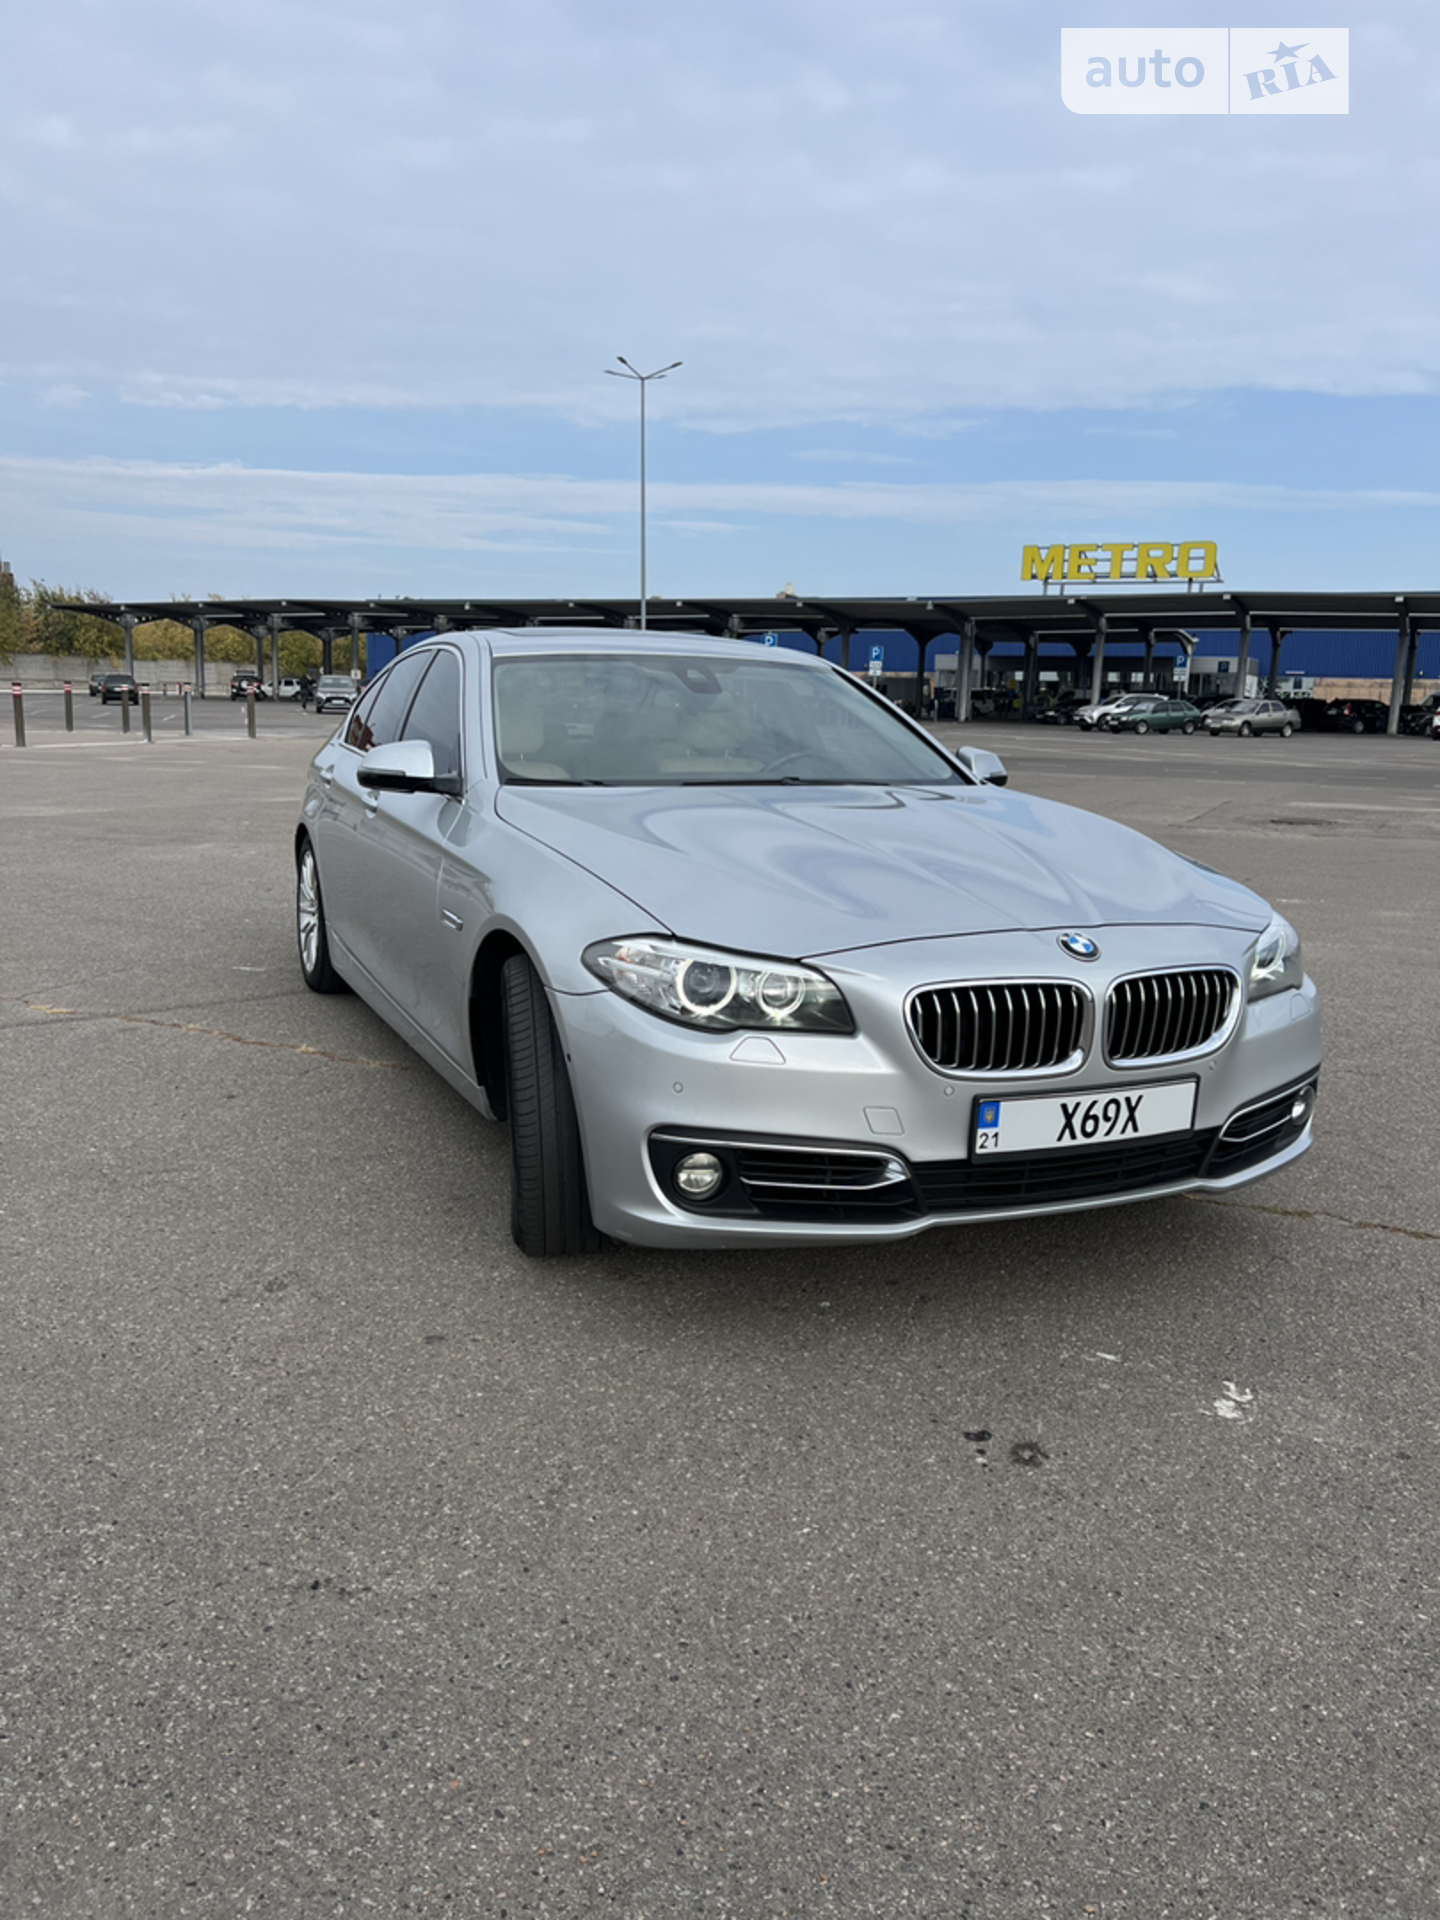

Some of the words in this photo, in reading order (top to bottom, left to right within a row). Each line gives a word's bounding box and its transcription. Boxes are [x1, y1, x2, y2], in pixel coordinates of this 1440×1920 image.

[1020, 540, 1217, 580] METRO
[1056, 1095, 1144, 1142] X69X
[978, 1132, 999, 1150] 21
